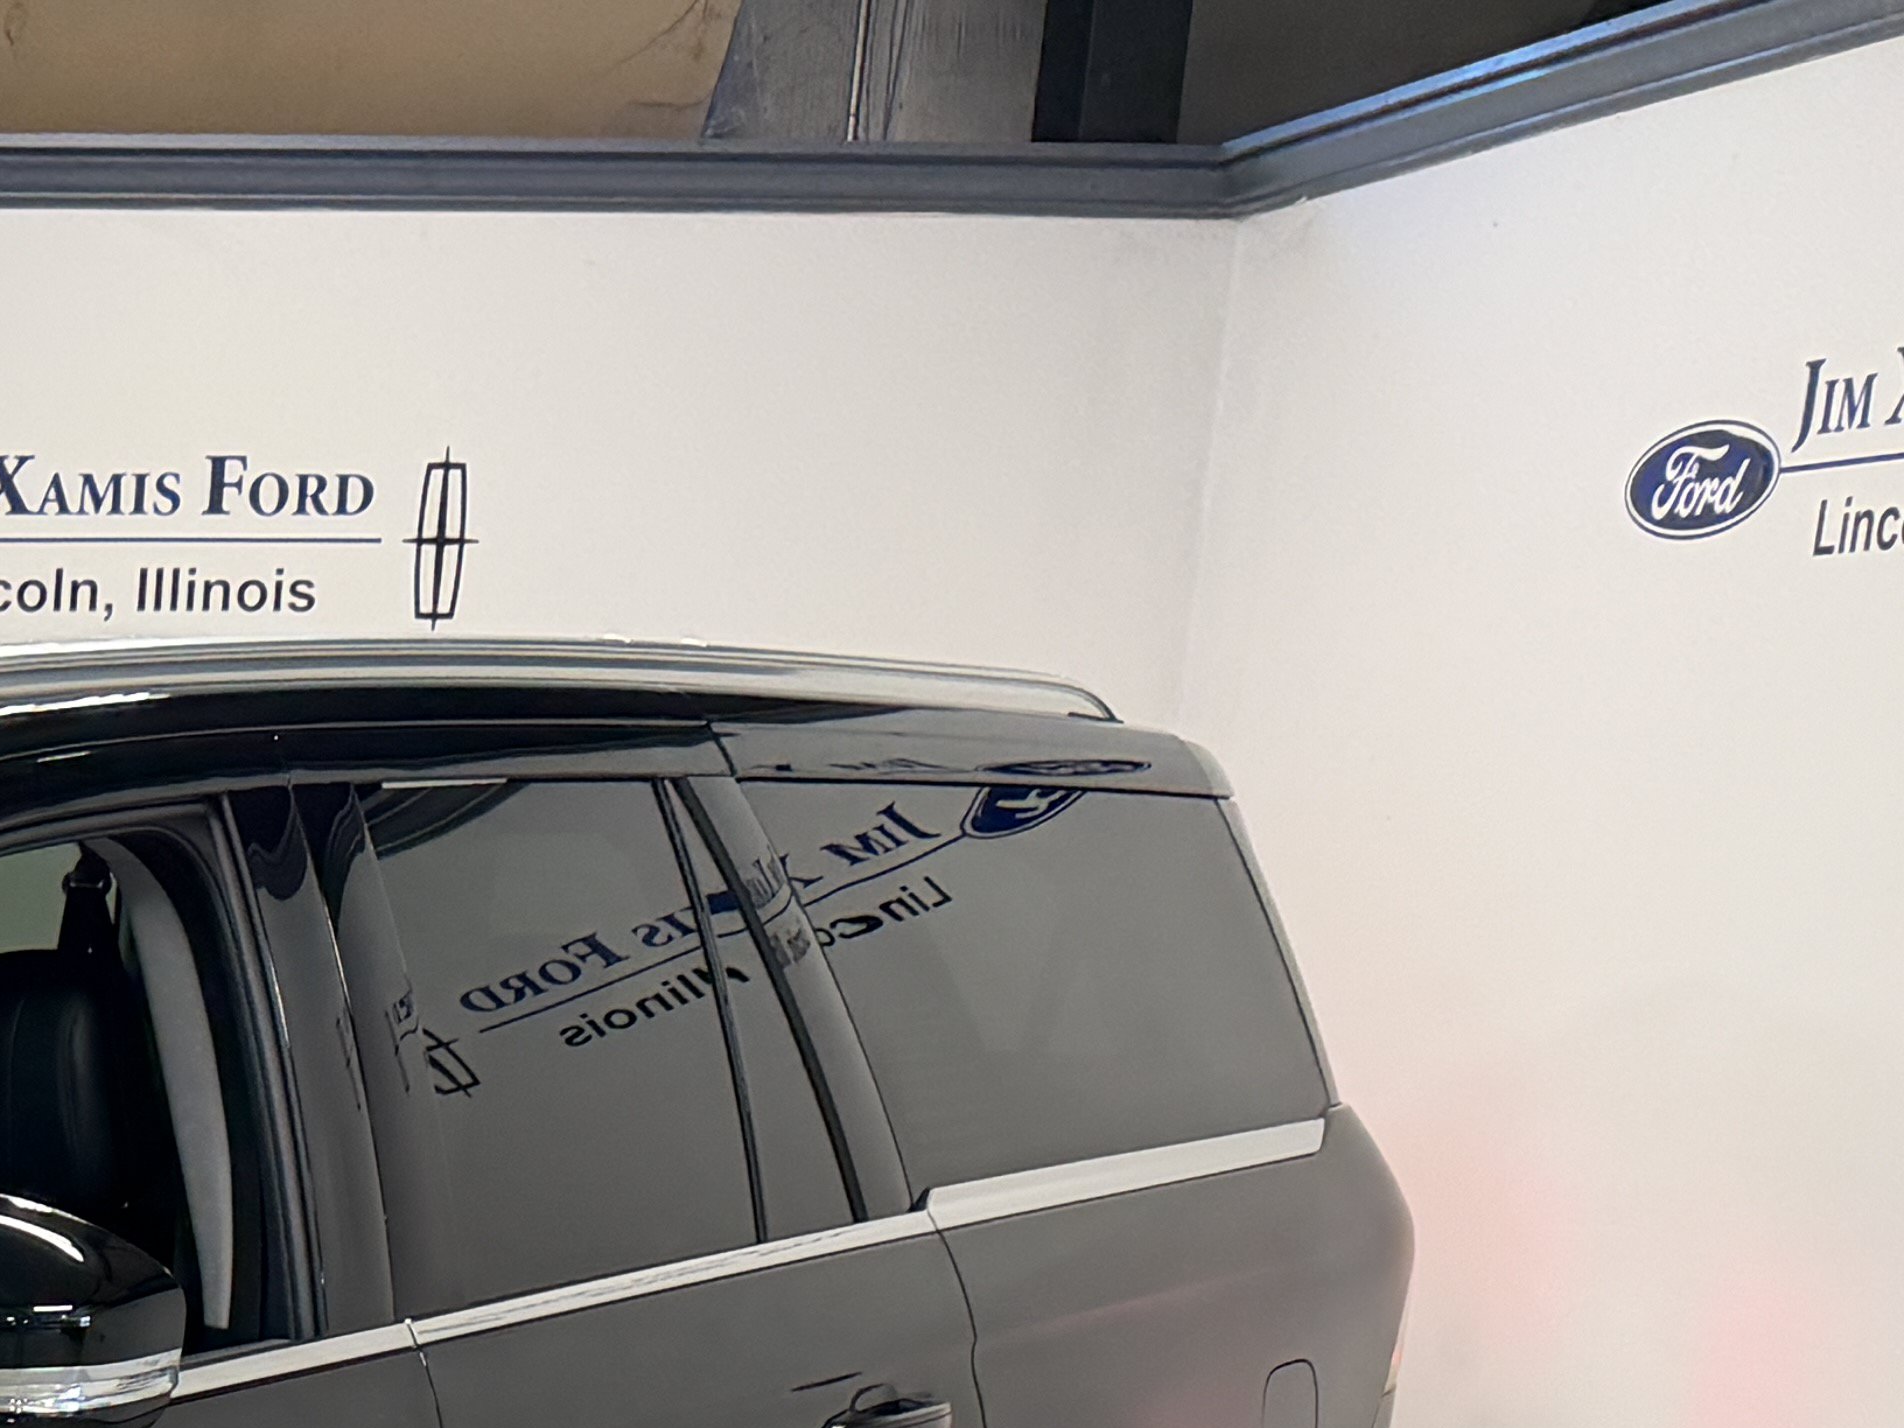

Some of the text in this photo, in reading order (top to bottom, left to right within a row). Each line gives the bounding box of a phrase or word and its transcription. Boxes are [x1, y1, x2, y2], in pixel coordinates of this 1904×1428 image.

[1791, 358, 1878, 453] JIM
[202, 455, 375, 517] FORD
[1651, 443, 1752, 521] Ford
[1812, 496, 1904, 556] Linc
[136, 567, 317, 613] Illinois
